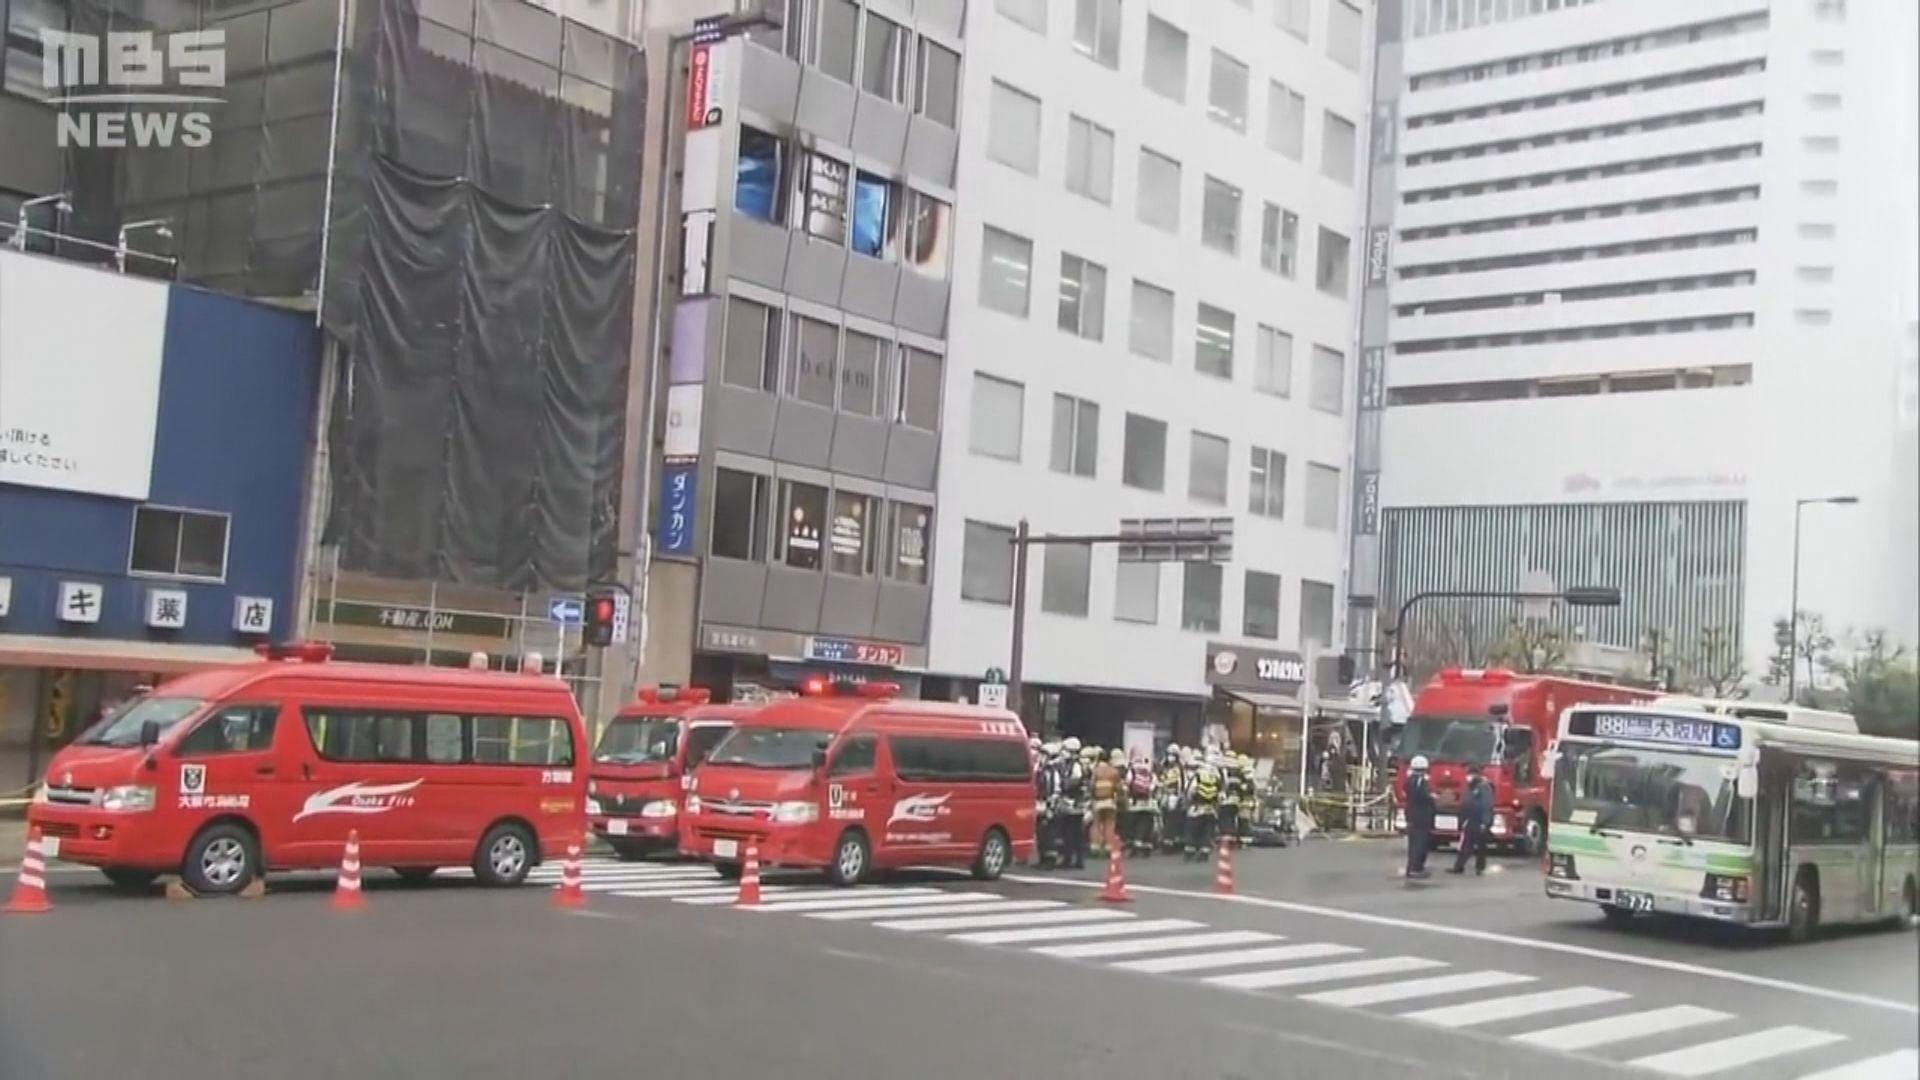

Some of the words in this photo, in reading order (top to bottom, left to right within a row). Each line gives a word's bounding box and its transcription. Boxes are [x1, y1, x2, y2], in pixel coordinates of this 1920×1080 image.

[668, 471, 688, 550] ダンカン
[856, 645, 899, 664] ダンカン
